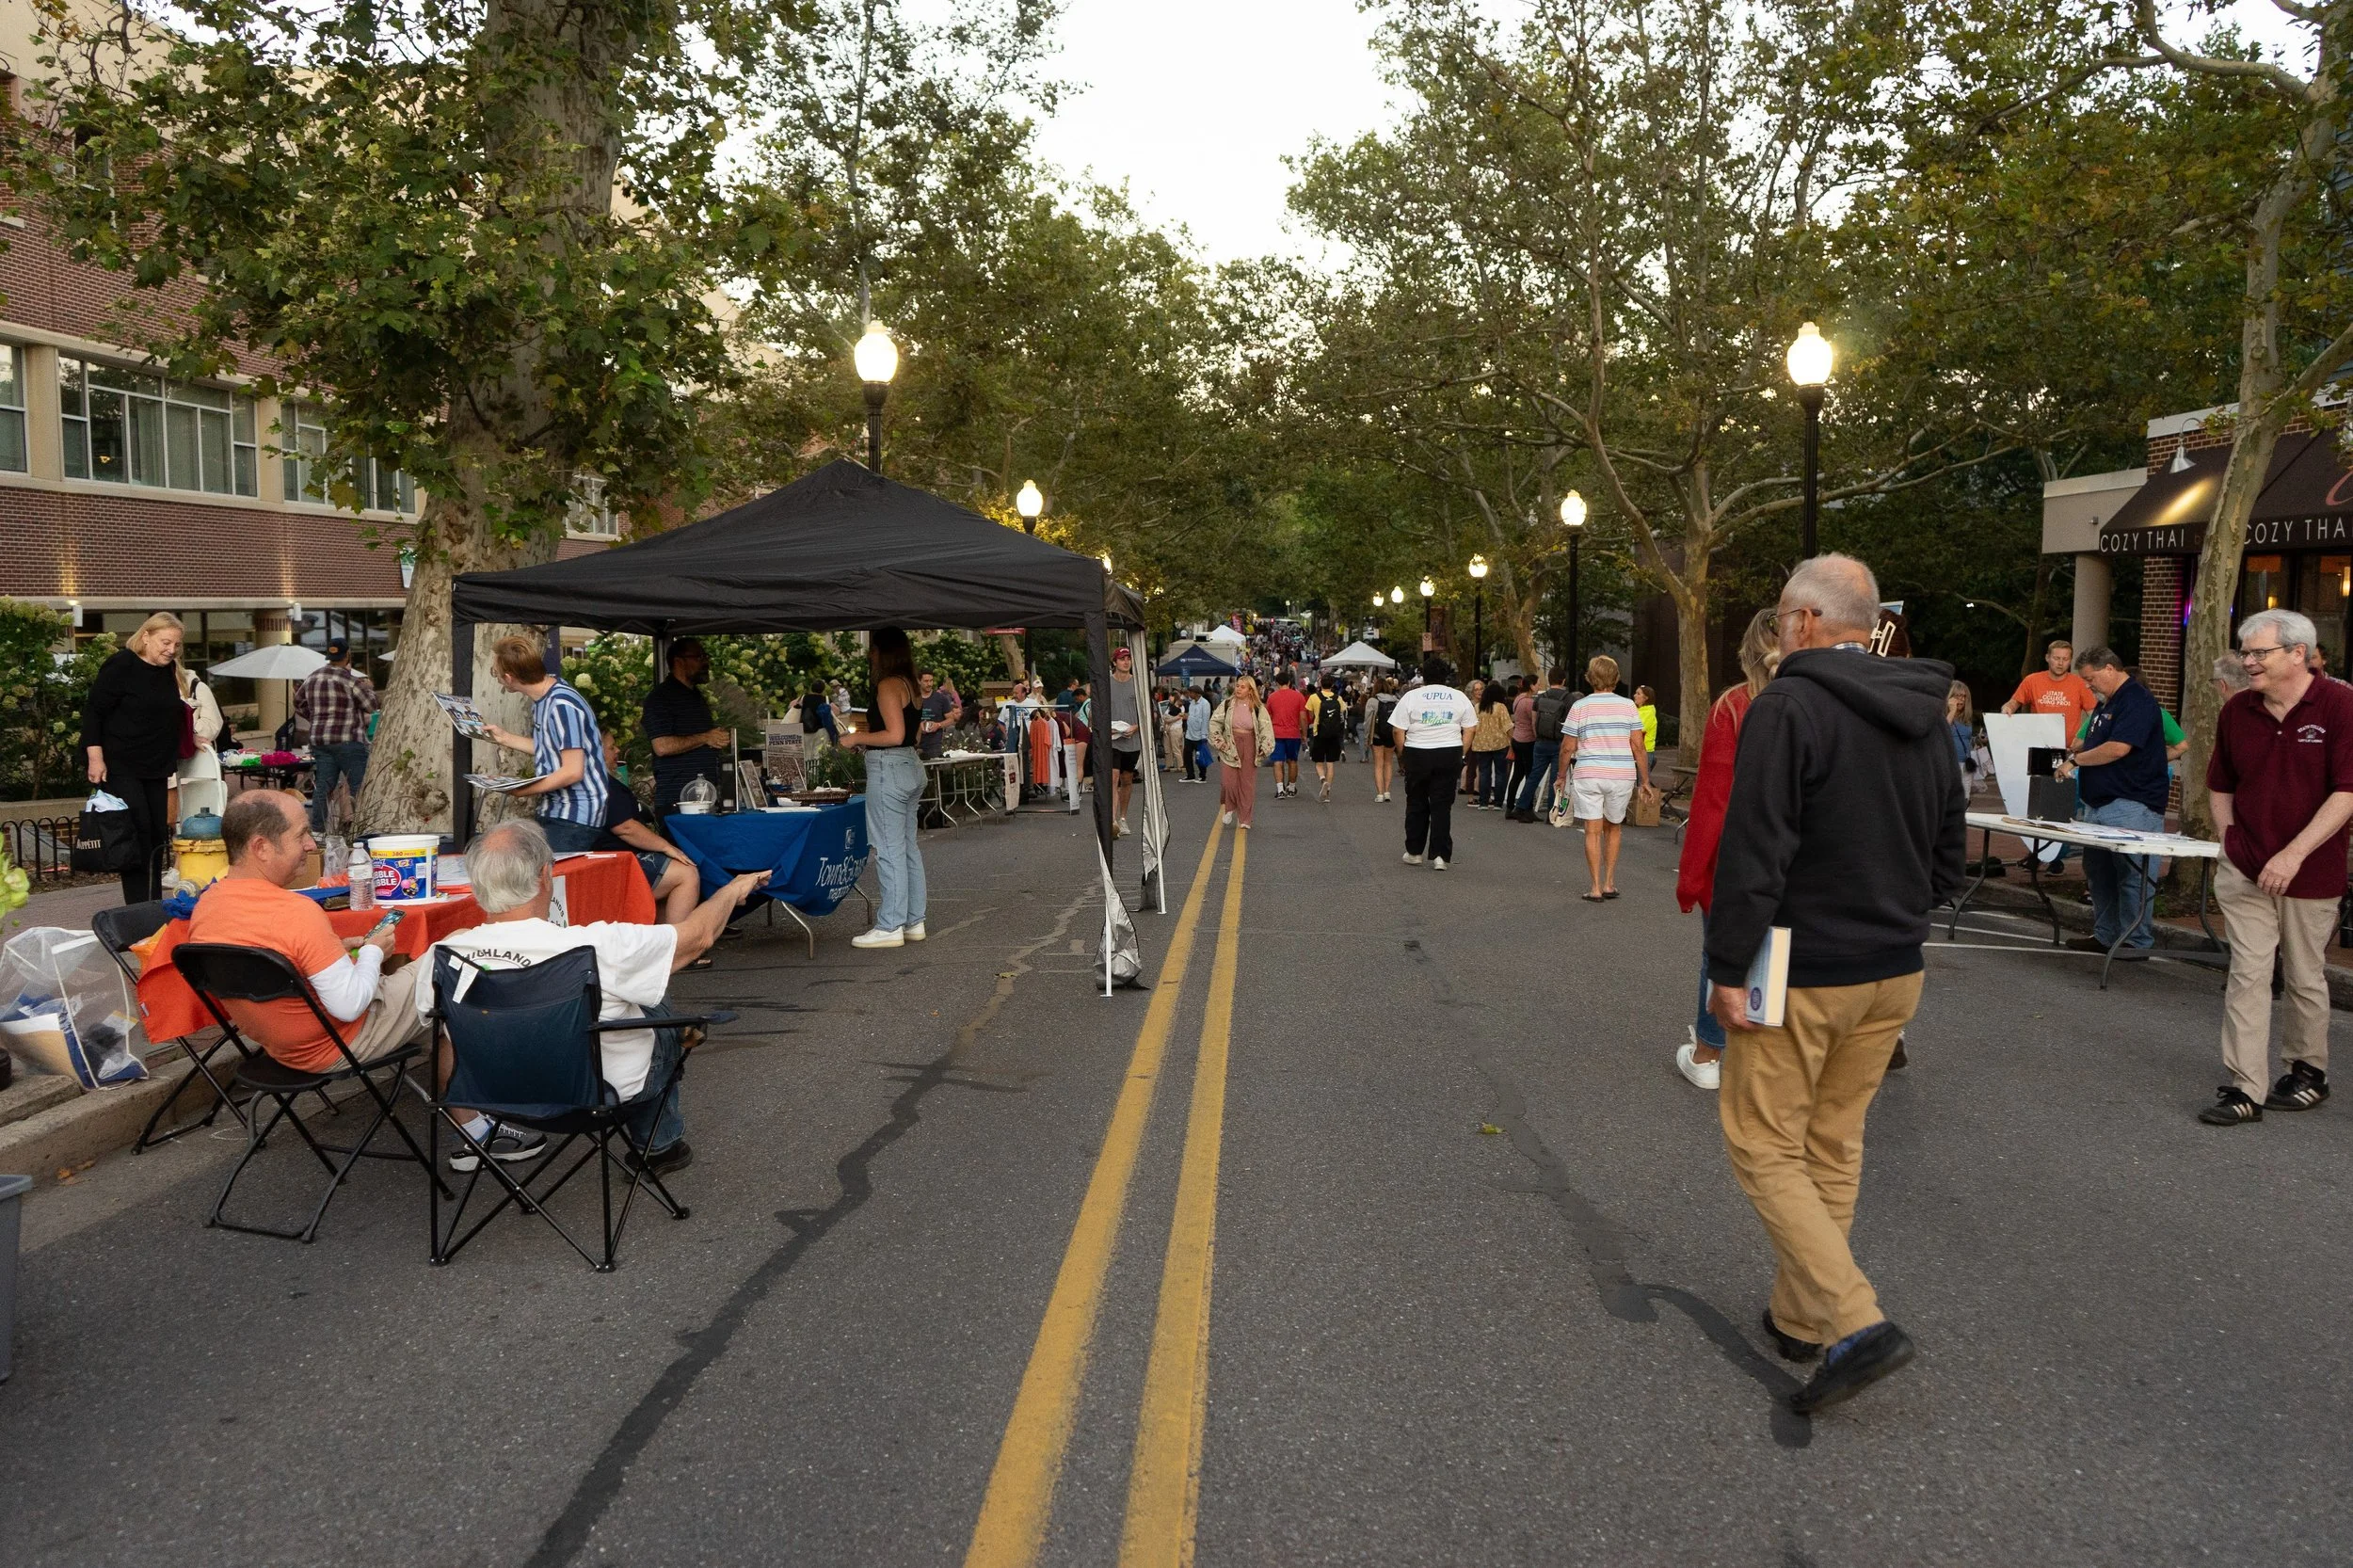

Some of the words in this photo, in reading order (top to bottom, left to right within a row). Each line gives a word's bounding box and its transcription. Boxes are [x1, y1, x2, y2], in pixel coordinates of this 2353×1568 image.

[2100, 532, 2139, 552] COZY
[2147, 529, 2185, 549] THAI
[2305, 517, 2353, 541] THA
